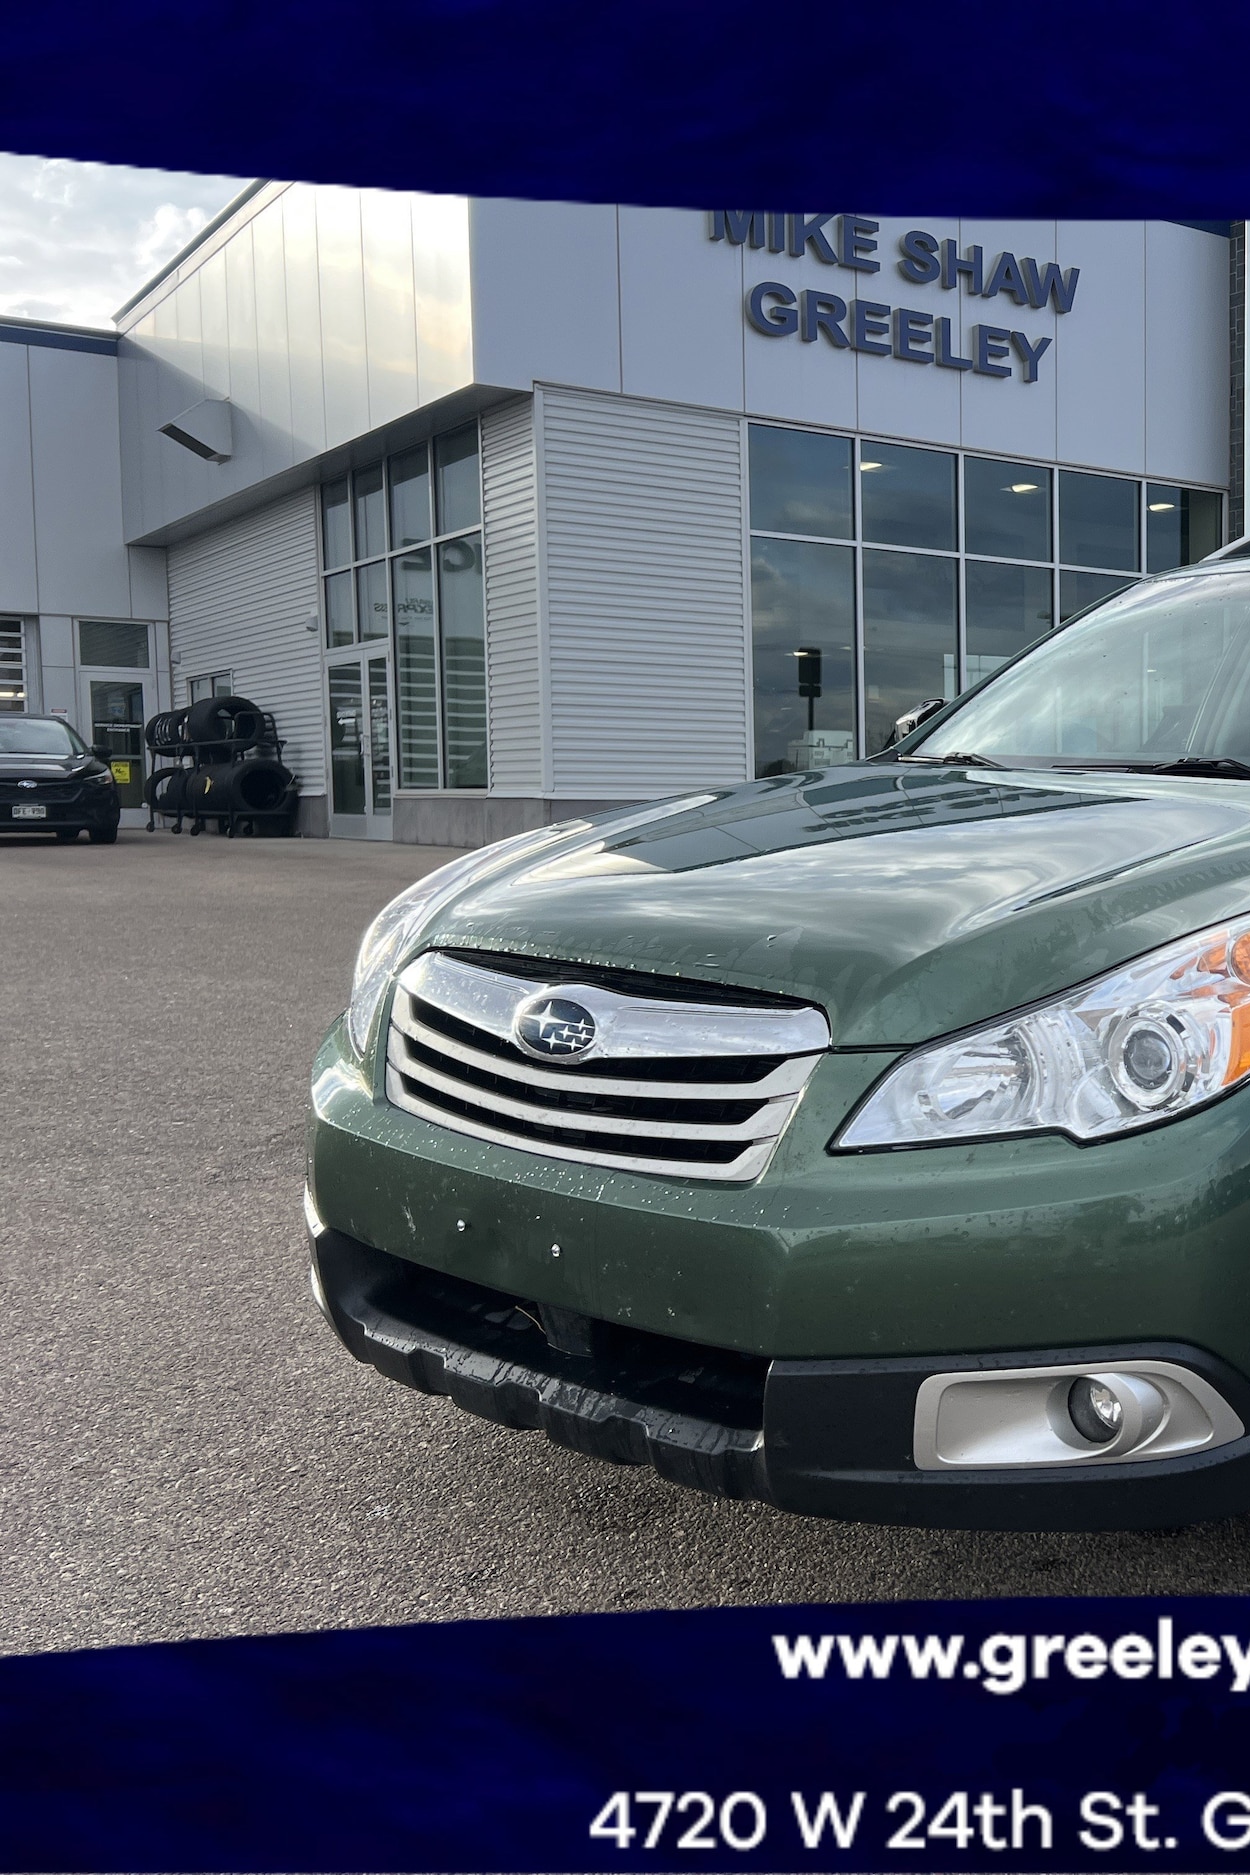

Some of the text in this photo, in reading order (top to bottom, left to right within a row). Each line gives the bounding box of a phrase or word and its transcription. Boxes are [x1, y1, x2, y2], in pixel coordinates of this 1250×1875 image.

[709, 210, 1080, 315] MIKE SHAW
[746, 282, 1052, 383] GREELEY
